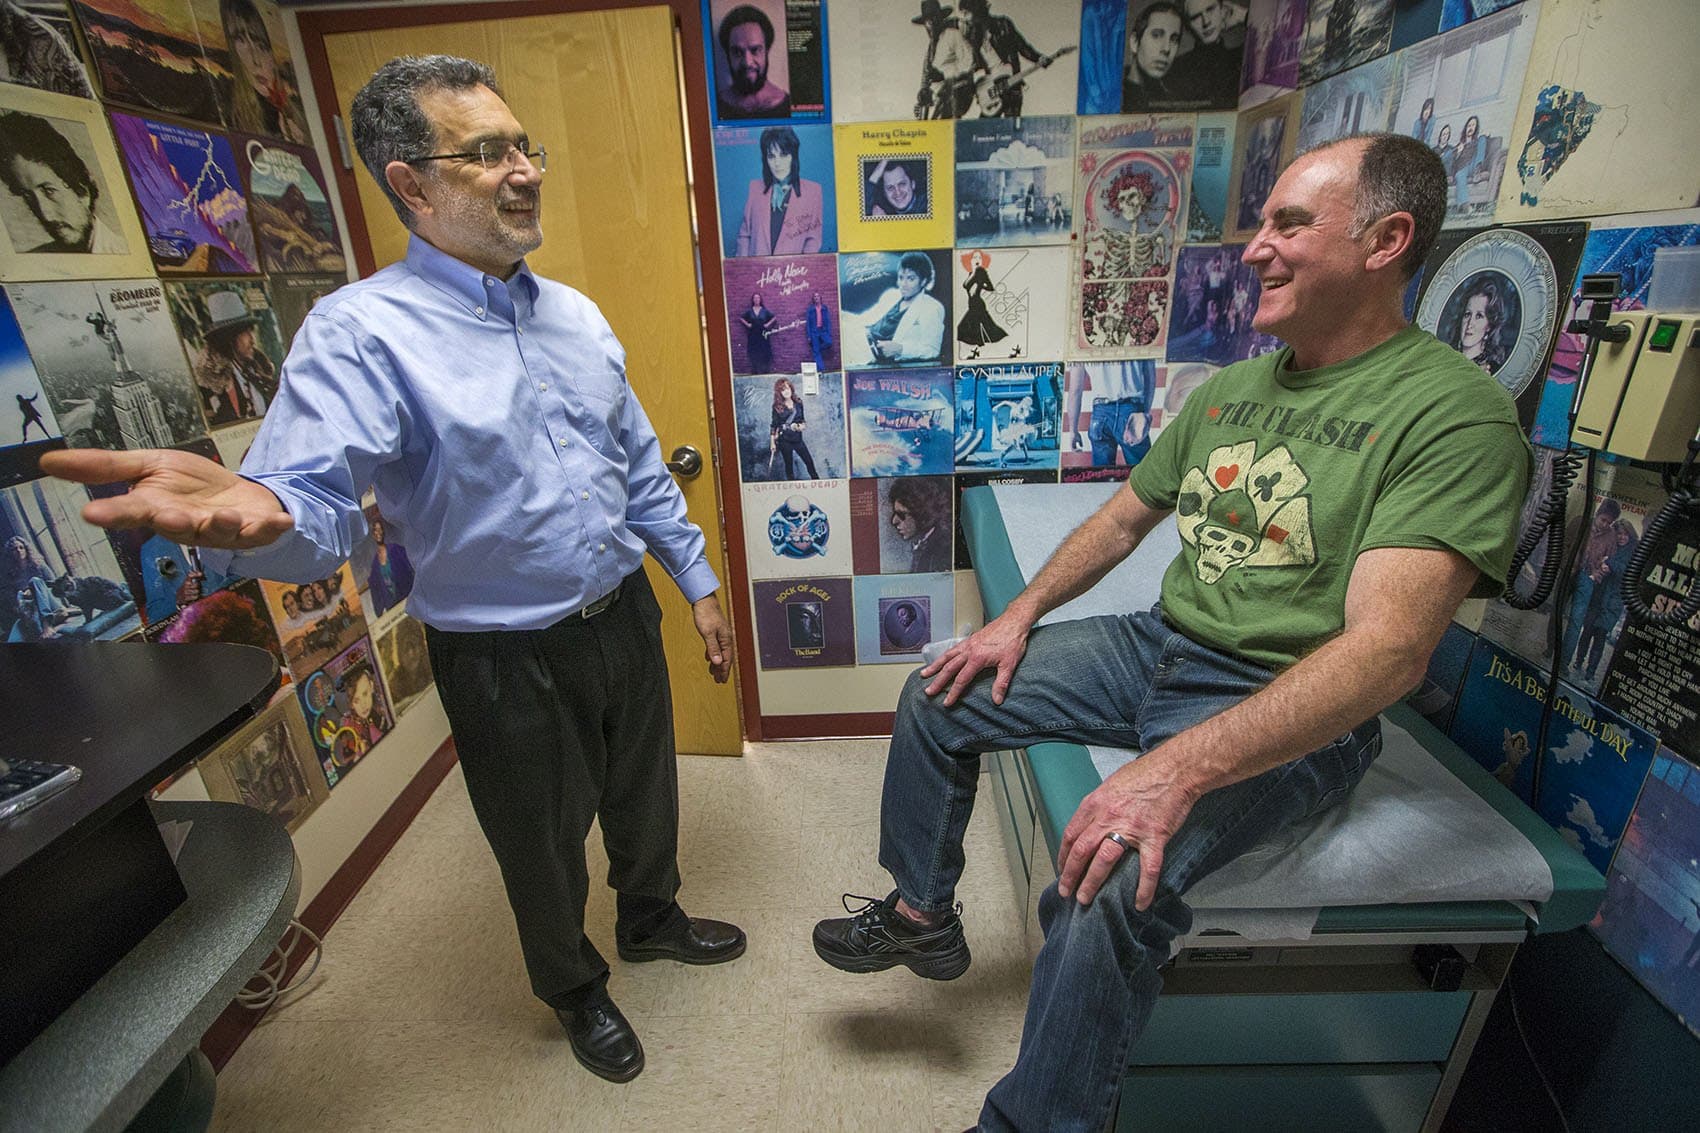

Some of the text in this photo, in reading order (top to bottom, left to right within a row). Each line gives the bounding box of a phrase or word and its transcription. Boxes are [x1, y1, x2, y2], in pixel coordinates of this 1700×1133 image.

[862, 128, 928, 139] Harry Chapin
[756, 267, 783, 288] Holly
[959, 364, 1064, 380] CYNDI LAUPER
[854, 378, 932, 400] JOE WALSH
[1215, 400, 1375, 452] THE CLASH
[753, 480, 838, 492] GRATEFUL DEAD
[1621, 503, 1648, 516] DYLAN
[776, 584, 832, 604] ROCK OF AGES
[1627, 626, 1635, 634] DO
[1670, 636, 1677, 644] TO
[1678, 640, 1689, 649] THE
[1654, 648, 1668, 658] LOST
[1673, 665, 1680, 674] TO
[1682, 670, 1694, 680] CRY
[1626, 678, 1637, 686] GET
[1648, 680, 1658, 690] YOU
[1658, 686, 1671, 697] LIVE
[1484, 654, 1632, 762] IT'S A BEUTIFUL DAY
[1667, 718, 1678, 729] YOU
